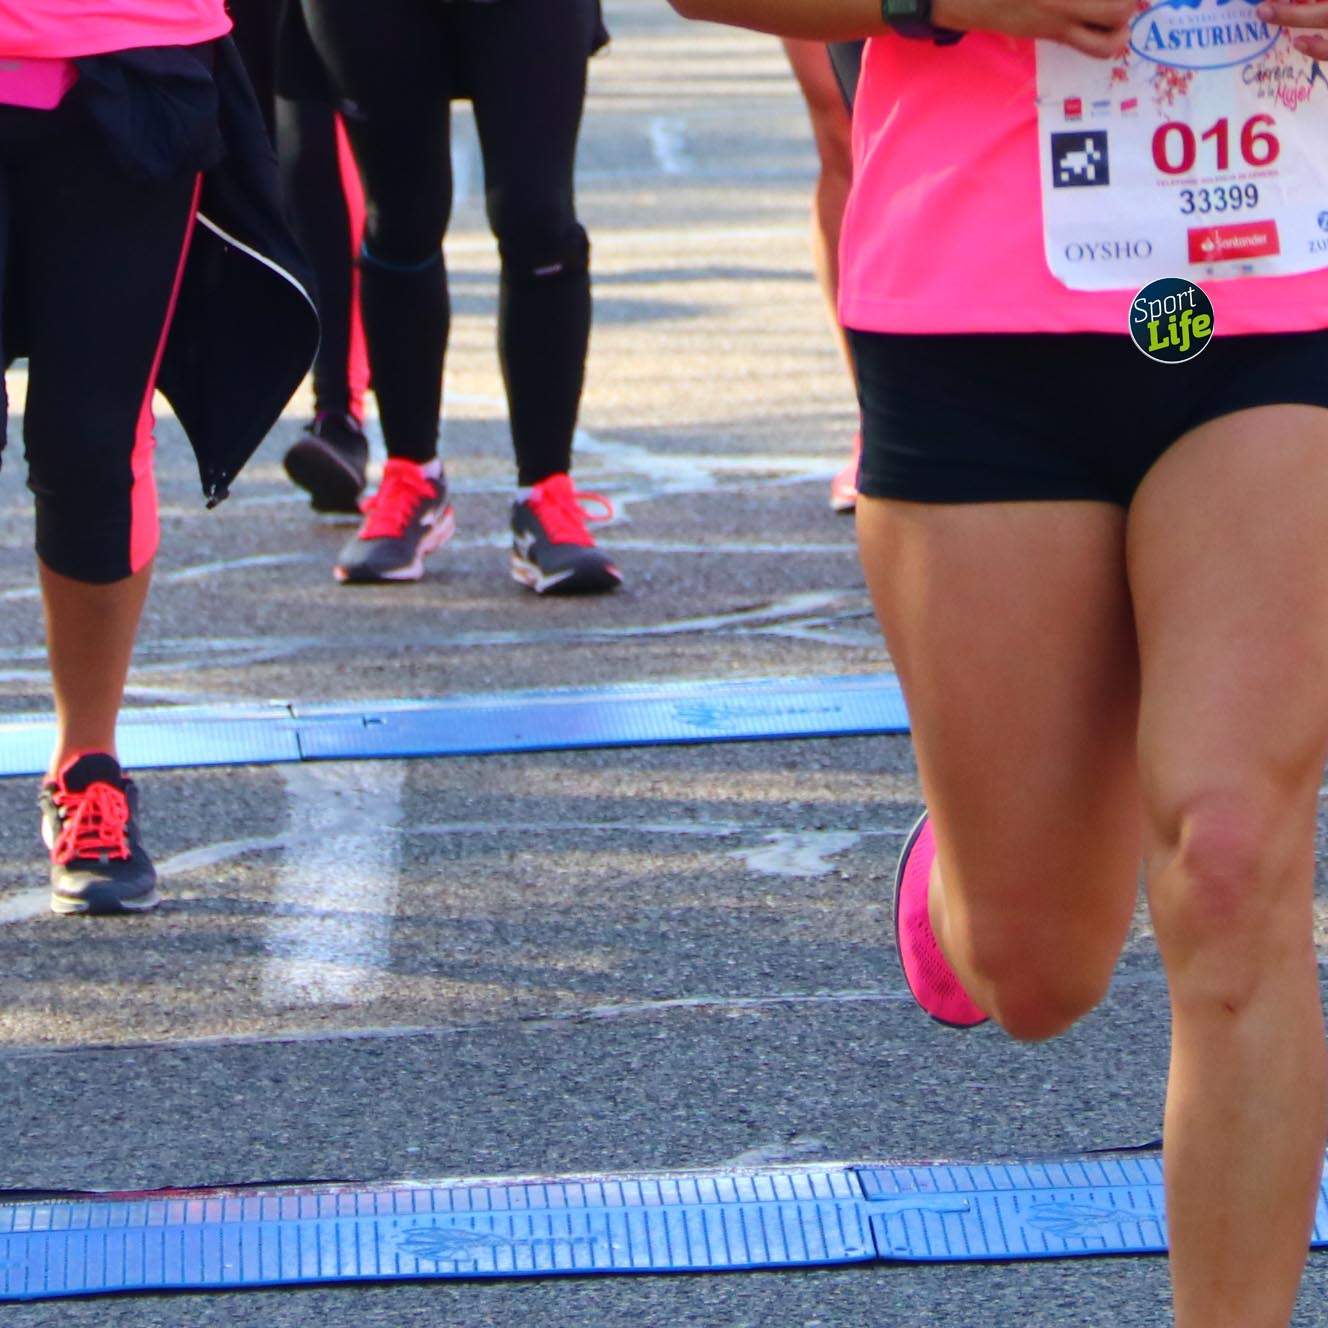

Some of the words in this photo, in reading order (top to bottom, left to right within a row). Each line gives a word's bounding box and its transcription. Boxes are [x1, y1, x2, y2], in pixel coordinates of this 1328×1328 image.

[1143, 22, 1272, 51] ASTURIANA
[1151, 113, 1281, 176] 016
[1179, 183, 1260, 215] 33399
[1064, 238, 1154, 263] OYSHO
